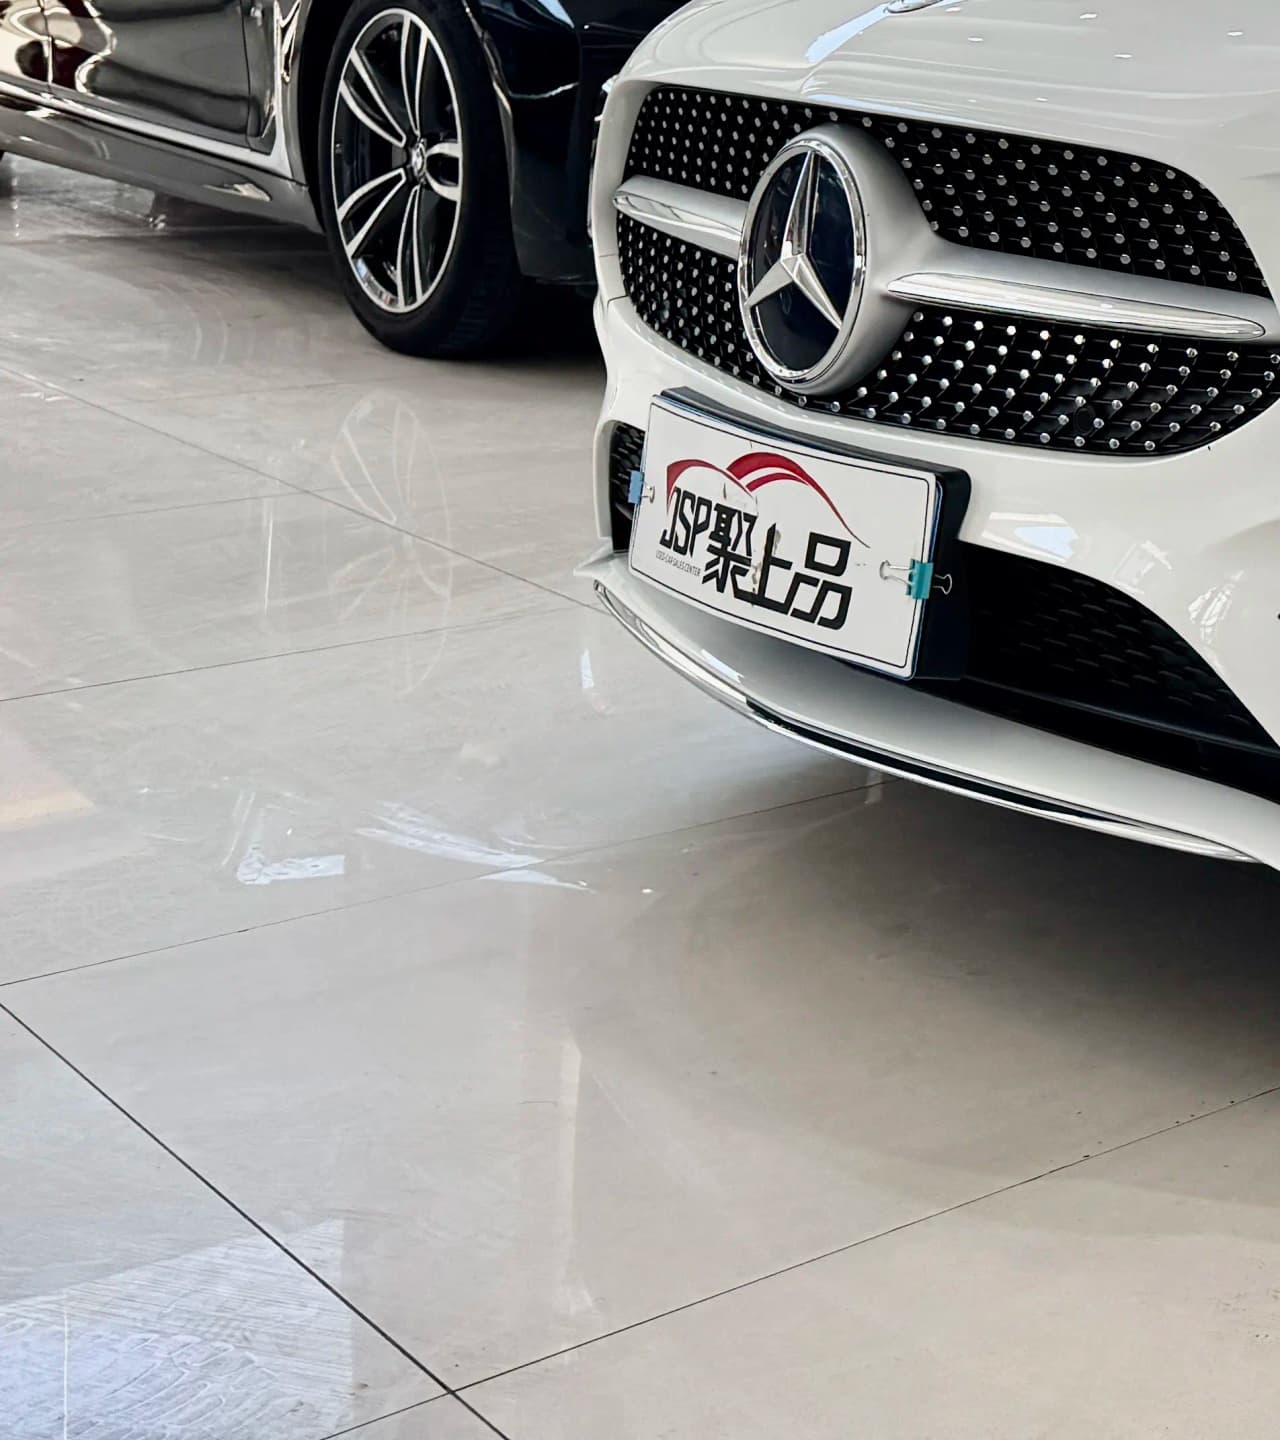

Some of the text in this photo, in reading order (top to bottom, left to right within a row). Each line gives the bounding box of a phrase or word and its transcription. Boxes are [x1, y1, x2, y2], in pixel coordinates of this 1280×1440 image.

[659, 485, 853, 631] JSP 聚上品
